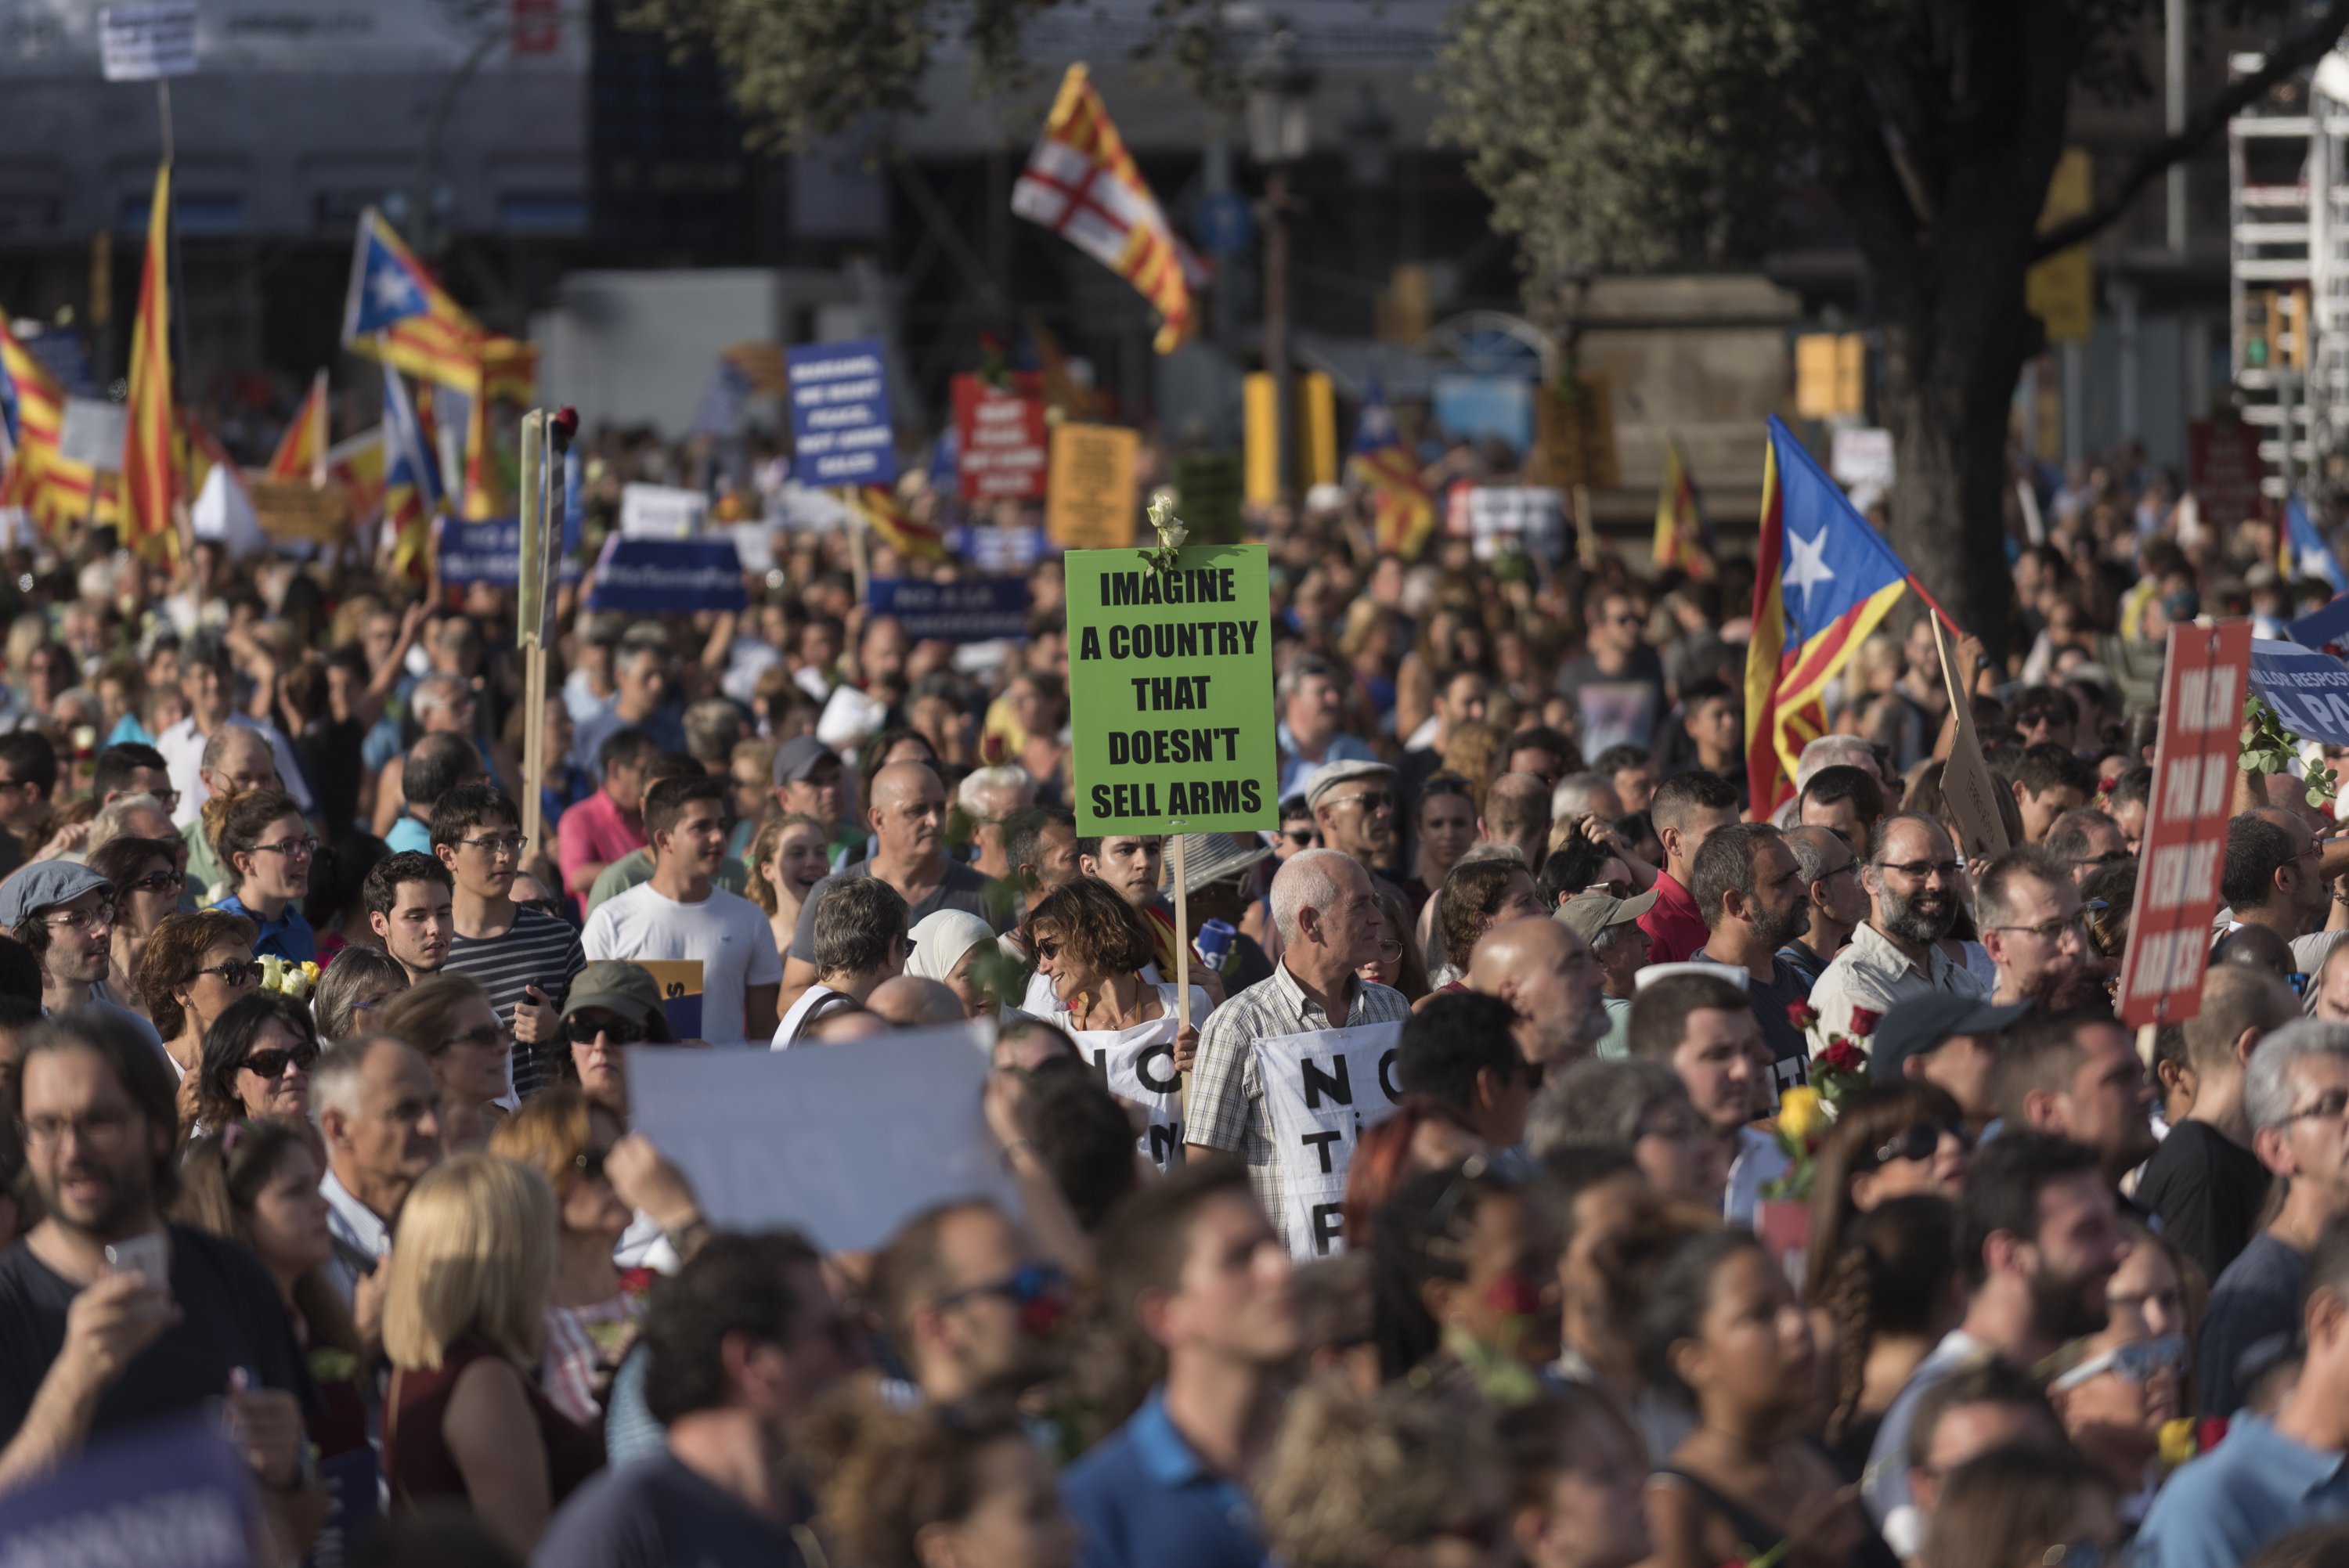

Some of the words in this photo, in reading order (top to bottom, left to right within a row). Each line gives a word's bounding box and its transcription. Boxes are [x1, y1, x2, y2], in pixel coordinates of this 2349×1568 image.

[1100, 568, 1236, 606] IMAGINE
[1081, 627, 1102, 660] A
[1110, 621, 1258, 659] COUNTRY
[1131, 676, 1211, 711] THAT
[1108, 728, 1239, 765] DOESN'T
[1092, 783, 1161, 818] SELL
[1167, 779, 1261, 816] ARMS
